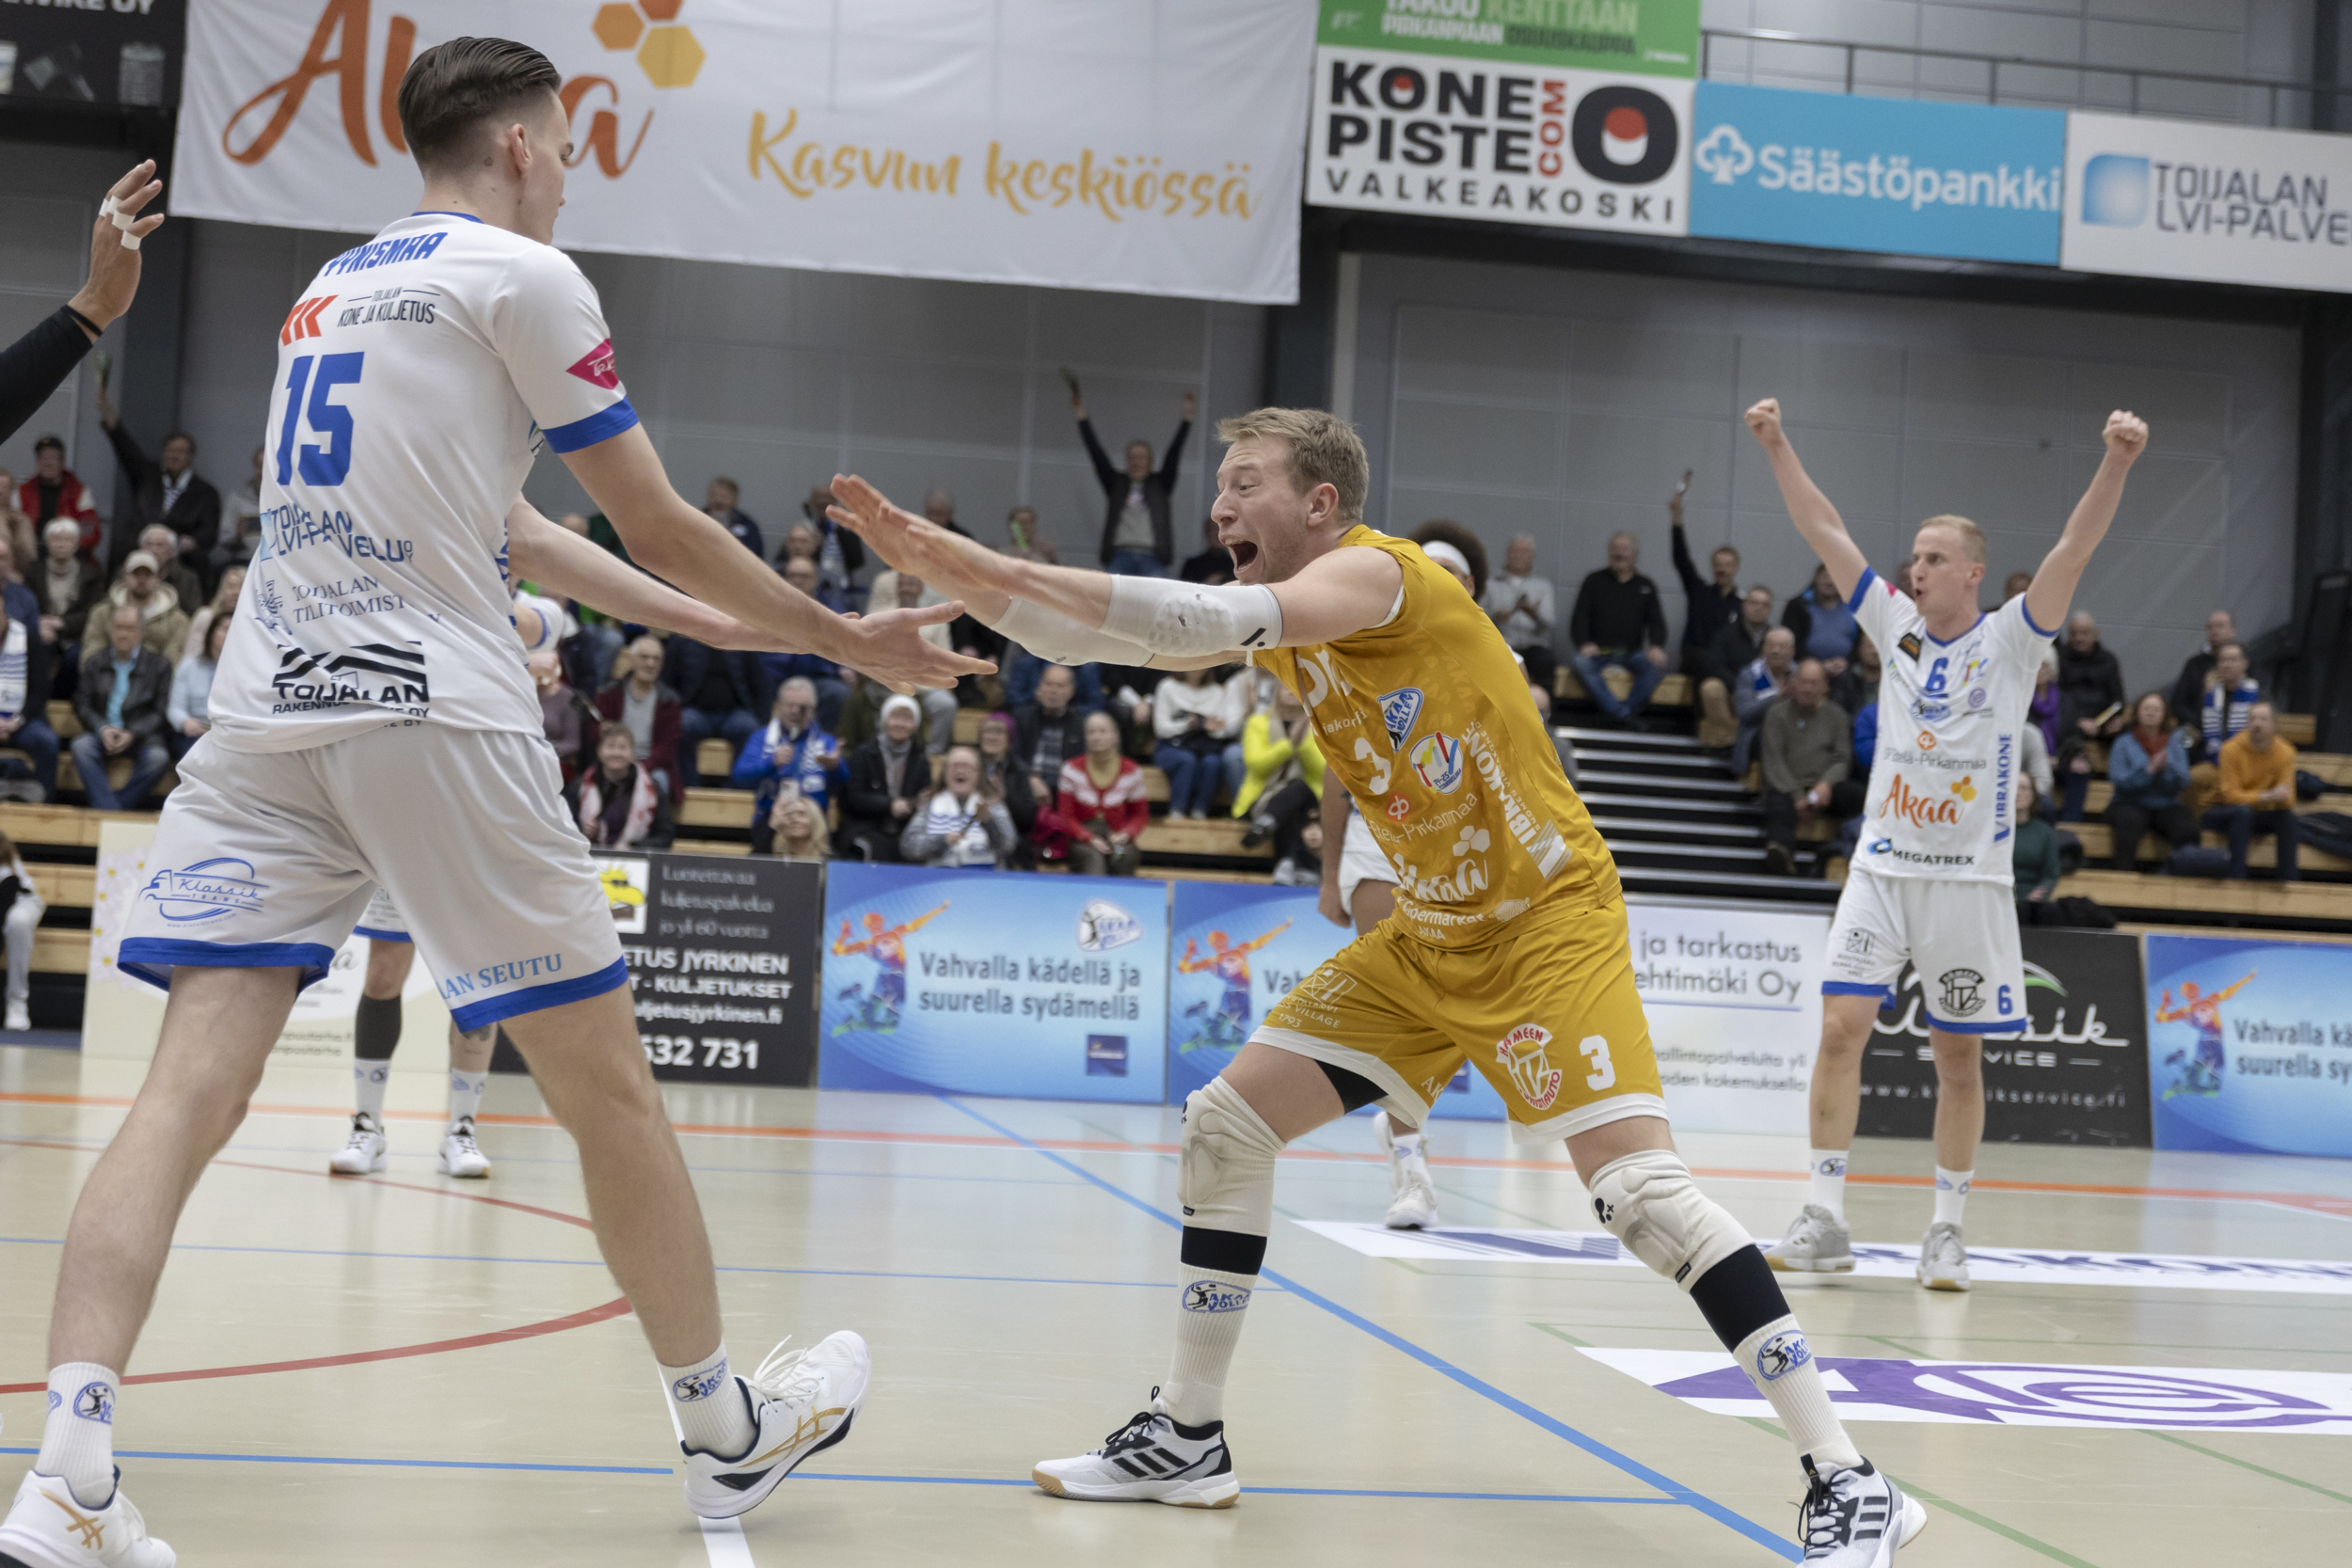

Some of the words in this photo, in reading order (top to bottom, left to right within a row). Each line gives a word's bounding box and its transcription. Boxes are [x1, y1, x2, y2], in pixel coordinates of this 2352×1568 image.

[1330, 61, 1535, 122] KONE
[1327, 114, 1534, 174] PISTE
[747, 108, 961, 199] Kasvun
[984, 141, 1263, 222] keskiössä
[1758, 143, 2061, 211] Säästöpankki
[1327, 167, 1673, 224] VALKEAKOSKI
[2154, 163, 2328, 208] TOIJALAN
[2156, 198, 2352, 246] LVI-PALVE
[374, 299, 436, 325] KULJETUS
[277, 352, 365, 486] 15
[294, 594, 405, 623] TILITOIMIST
[1926, 657, 1949, 691] 6
[1879, 773, 1964, 830] Akaa
[178, 878, 264, 901] Klassik
[622, 944, 677, 970] ETUS
[679, 948, 790, 975] JYRKINEN
[1640, 931, 1666, 961] ja
[1677, 930, 1803, 963] tarkastus
[478, 953, 563, 989] SEUTU
[654, 974, 793, 1000] KULJETUKSET
[919, 952, 1020, 982] Vahvalla
[1028, 957, 1112, 987] kädellä
[1119, 962, 1141, 993] ja
[1635, 962, 1748, 995] ehtimäki
[1757, 969, 1803, 1005] Oy
[918, 989, 1014, 1015] suurella
[1023, 991, 1140, 1023] sydämellä
[1295, 1005, 1342, 1029] VILLAGE
[1997, 985, 2014, 1016] 6
[1278, 1013, 1303, 1029] 1793
[700, 1036, 759, 1069] 731
[1499, 1027, 1544, 1057] HÄMEEN
[1916, 1046, 2058, 1067] SVICE
[1579, 1034, 1616, 1091] 3
